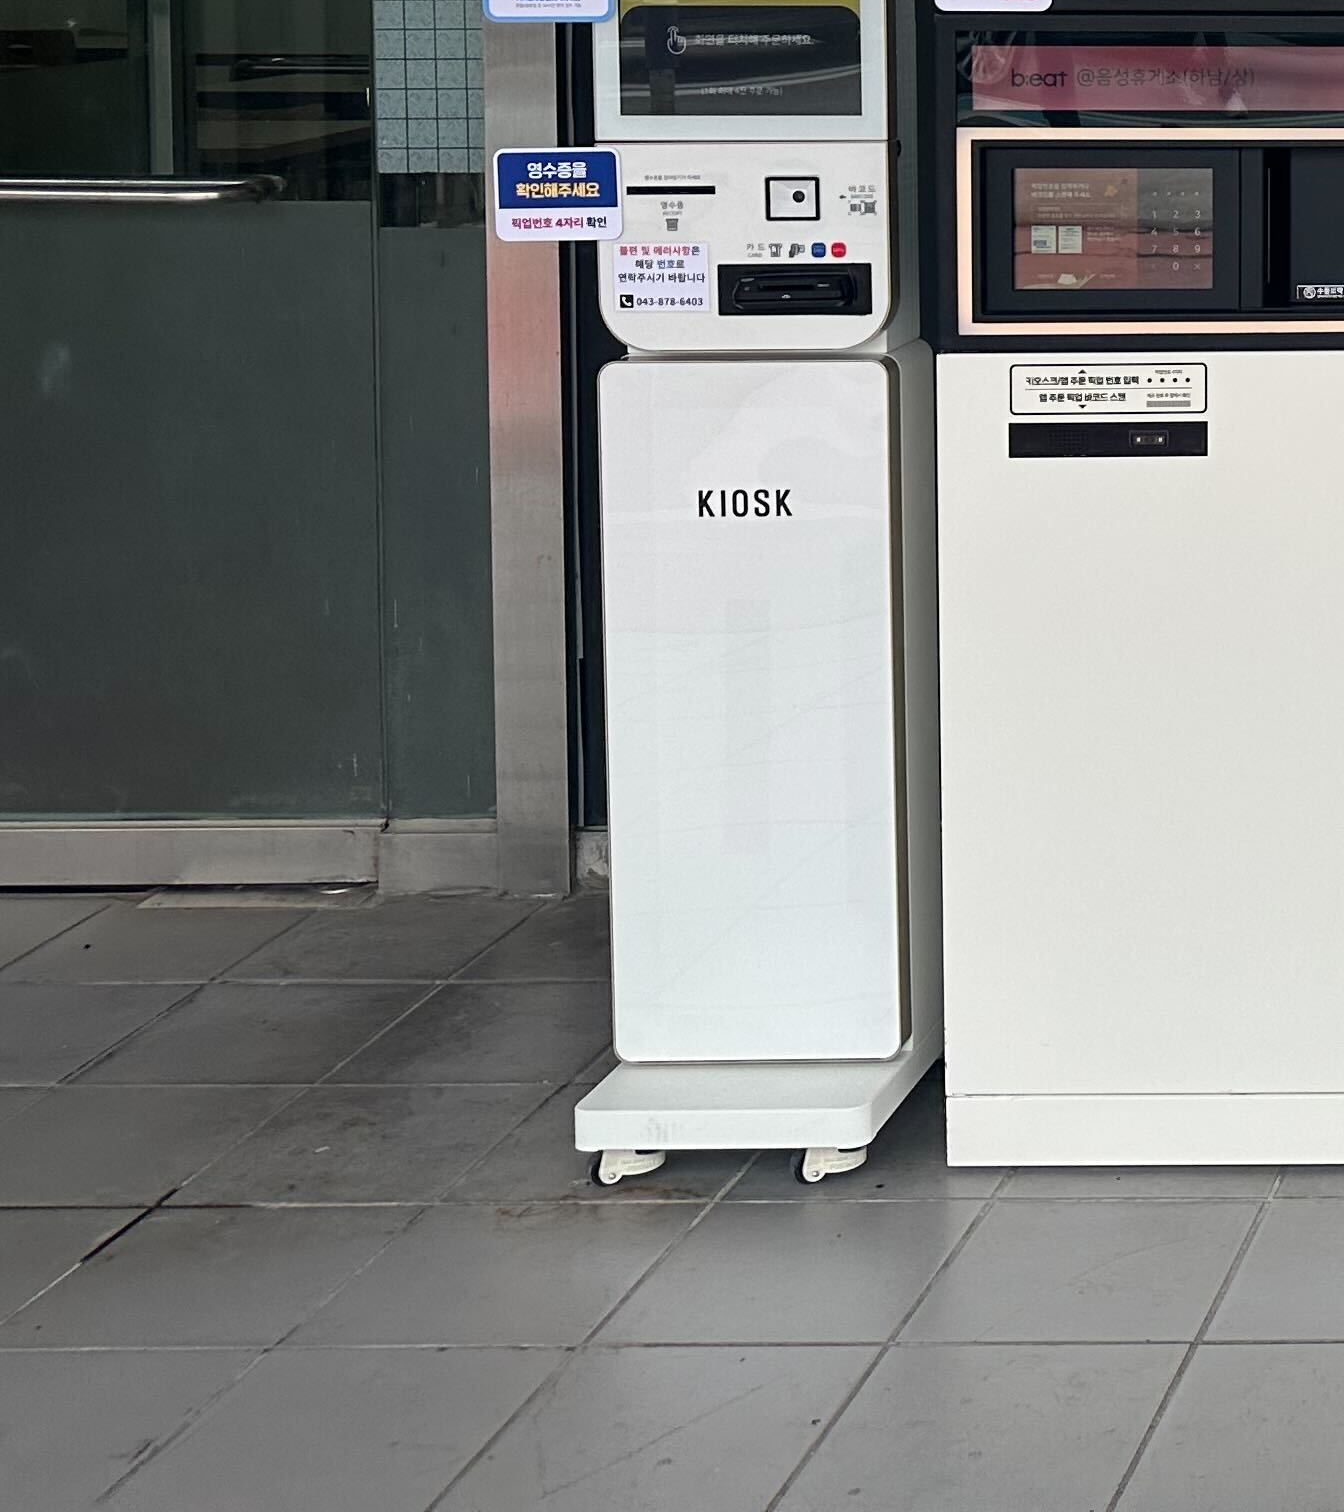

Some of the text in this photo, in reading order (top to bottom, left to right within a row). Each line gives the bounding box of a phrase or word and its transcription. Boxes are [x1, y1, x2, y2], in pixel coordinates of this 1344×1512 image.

[527, 162, 588, 179] 영수증을
[515, 182, 601, 199] 확인해주세요
[511, 216, 608, 230] 픽업번호 4자리 확인
[635, 259, 653, 270] 해당
[618, 272, 706, 284] 연락주시기 바랍니다
[698, 489, 793, 517] KIOSK
